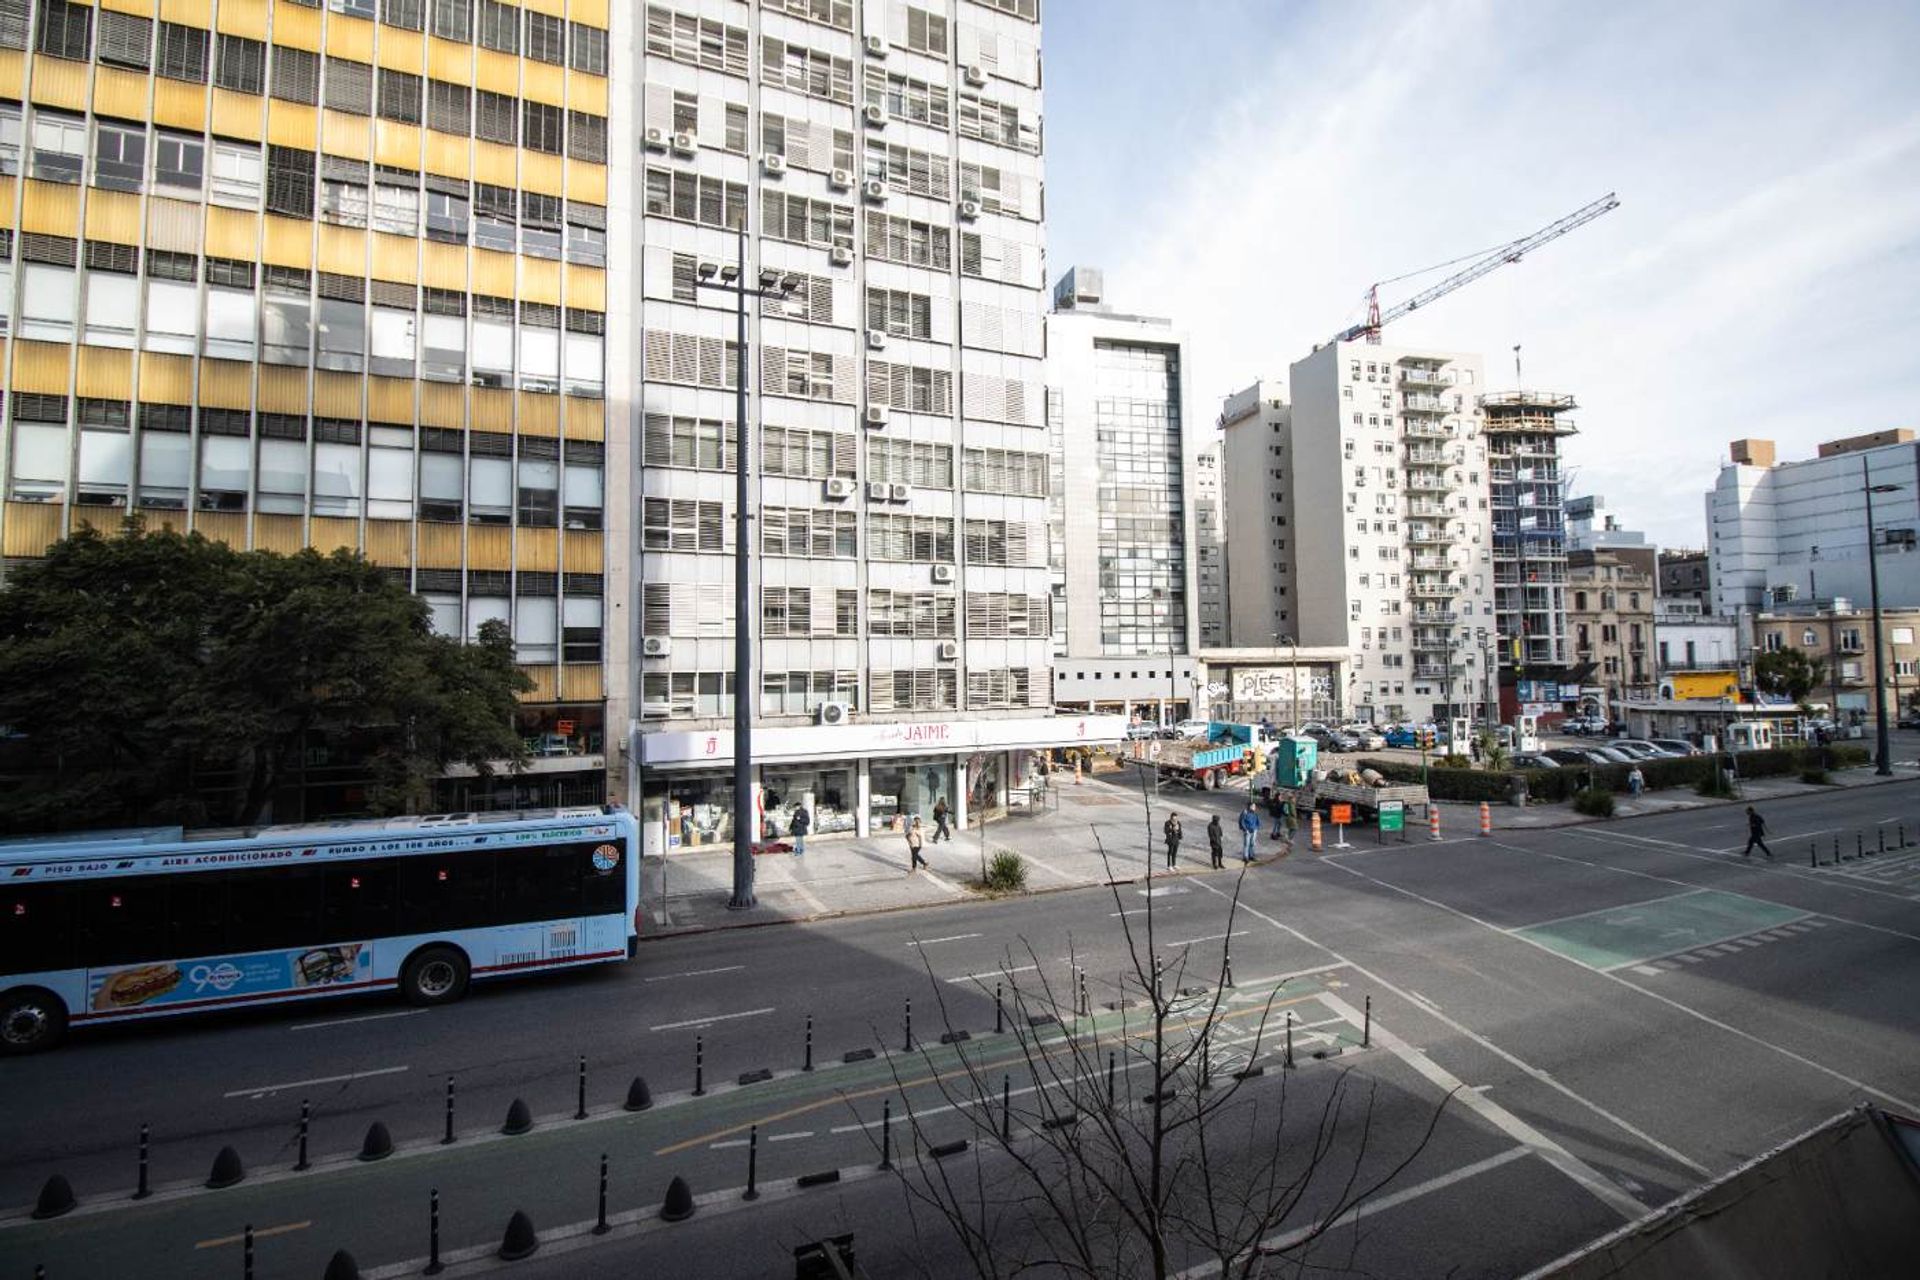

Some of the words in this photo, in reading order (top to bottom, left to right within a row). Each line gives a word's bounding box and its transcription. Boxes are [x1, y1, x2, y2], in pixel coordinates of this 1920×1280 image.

[328, 845, 366, 854] RUMBO
[370, 844, 376, 852] A
[381, 843, 400, 851] LOS
[162, 857, 189, 866] AIRE
[194, 850, 293, 864] ACONDICIONADO
[44, 865, 73, 875] PISO
[78, 862, 109, 872] BAJO
